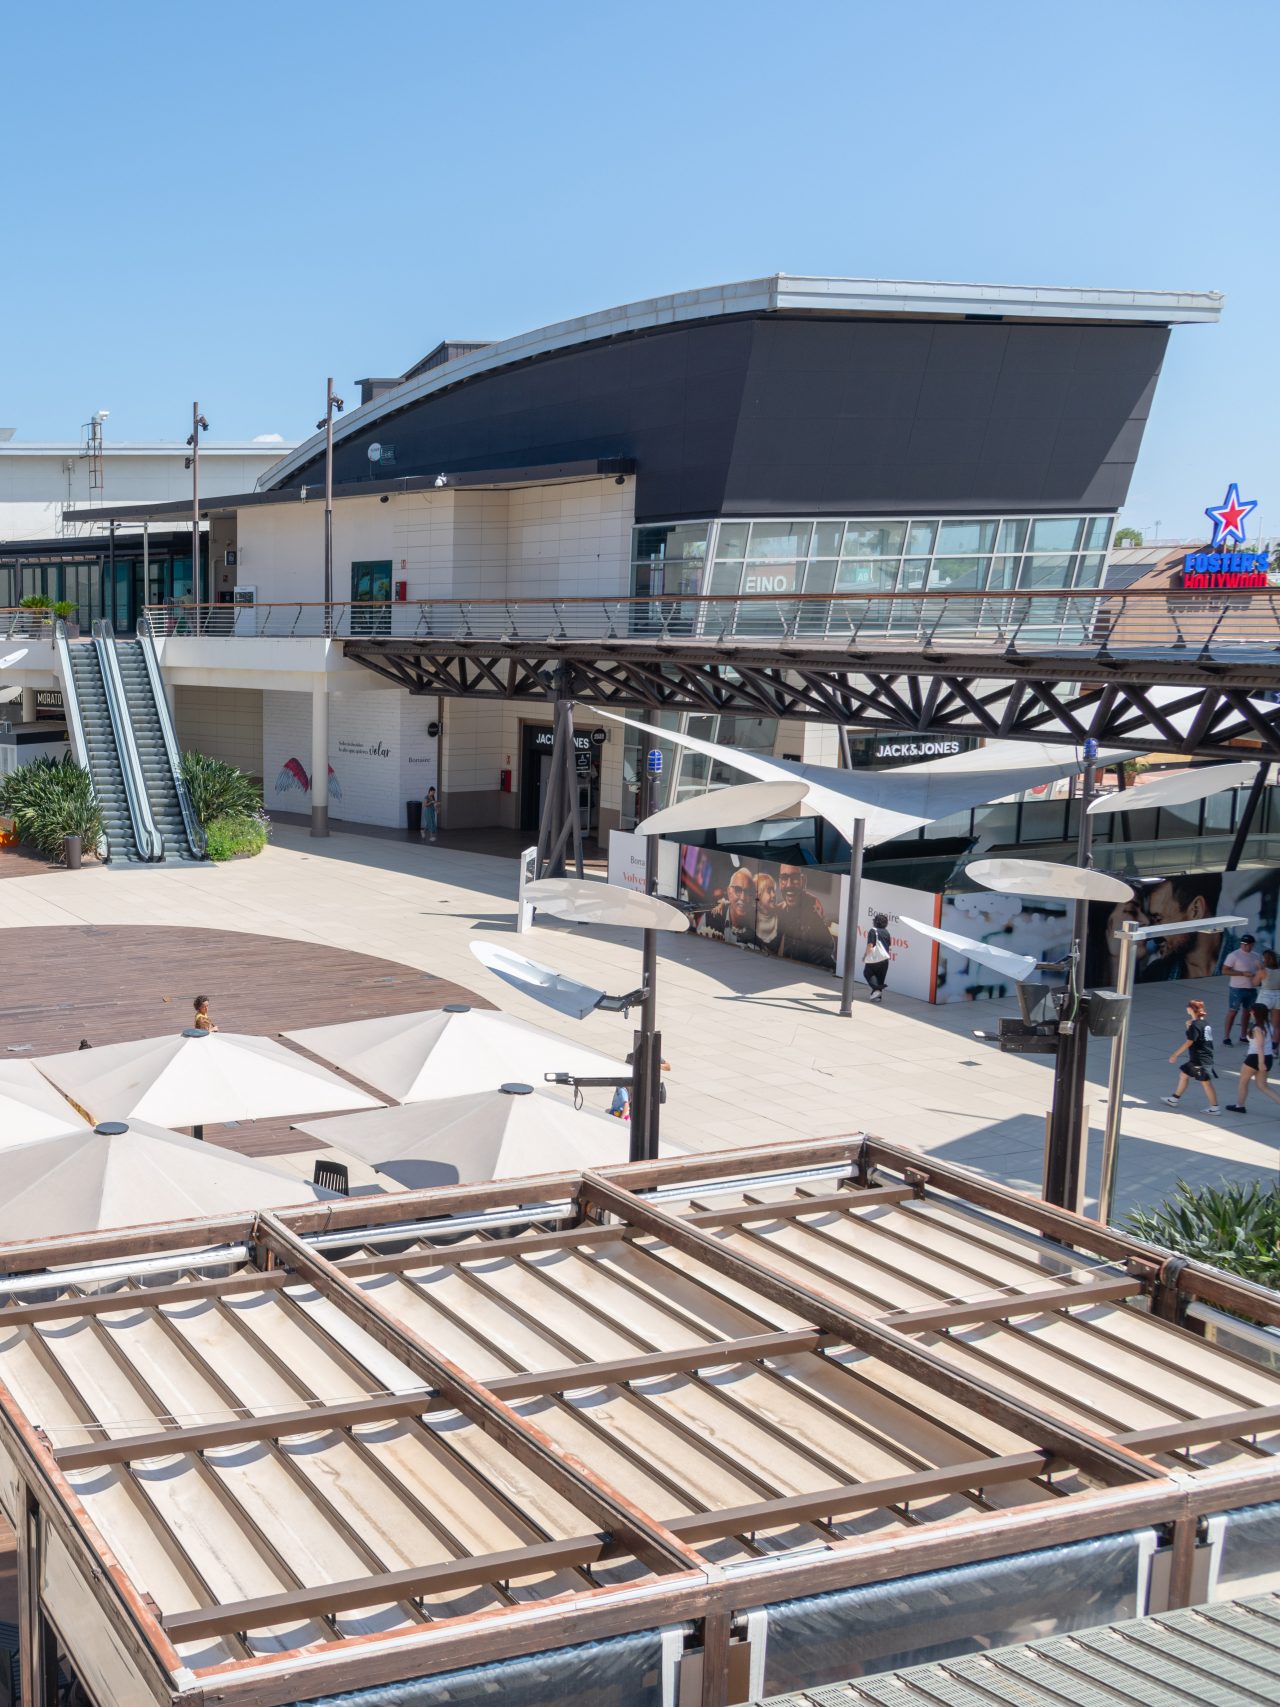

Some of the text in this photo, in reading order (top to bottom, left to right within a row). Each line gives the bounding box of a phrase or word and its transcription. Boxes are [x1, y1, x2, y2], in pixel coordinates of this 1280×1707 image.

[1184, 552, 1270, 573] FOSTER'S
[1184, 573, 1267, 588] HOLLYWOOD
[37, 692, 62, 705] MORATO
[877, 742, 960, 758] JACK&JONES
